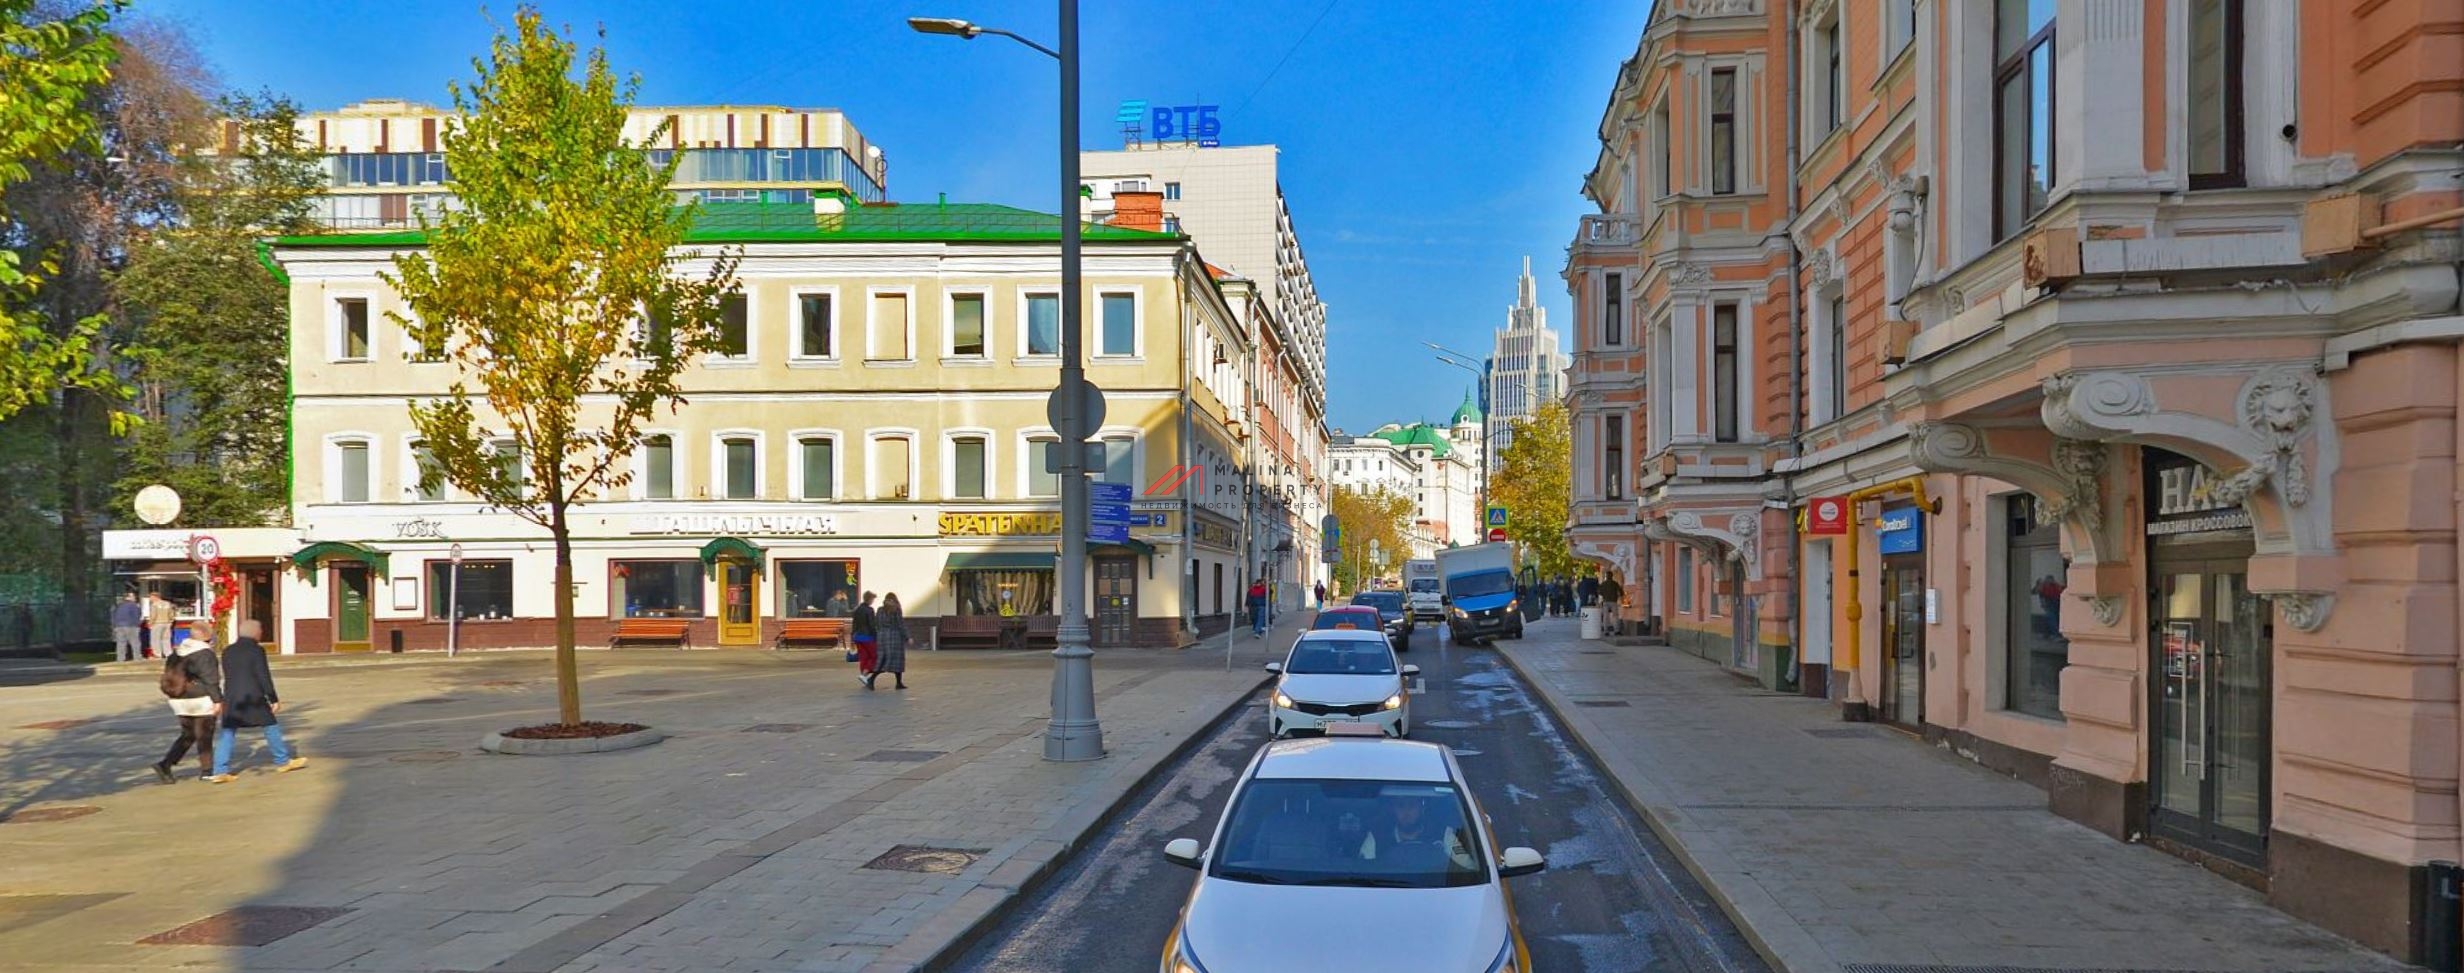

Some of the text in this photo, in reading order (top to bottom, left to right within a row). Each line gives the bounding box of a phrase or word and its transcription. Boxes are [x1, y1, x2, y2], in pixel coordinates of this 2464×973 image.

[1152, 105, 1221, 138] ВТБ
[1156, 515, 1164, 525] 2
[201, 543, 214, 555] 20
